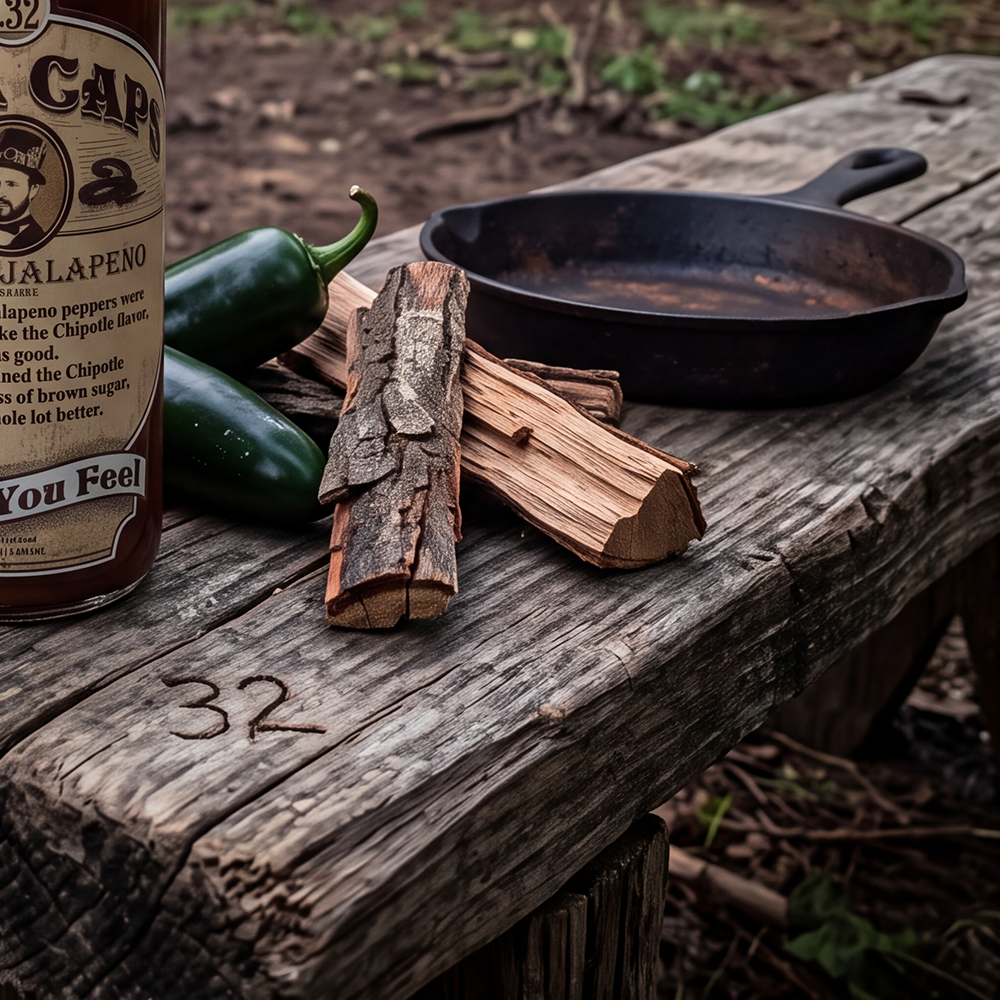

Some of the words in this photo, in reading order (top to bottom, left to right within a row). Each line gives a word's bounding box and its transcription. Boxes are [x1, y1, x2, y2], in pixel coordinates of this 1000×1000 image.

[28, 54, 161, 163] CAPS
[61, 297, 118, 321] peppers
[120, 289, 145, 306] were
[22, 325, 49, 341] the
[53, 317, 115, 340] Chipotle
[117, 308, 149, 328] flavor,
[13, 345, 59, 367] good.
[36, 366, 62, 382] the
[65, 356, 124, 380] Chipotle
[16, 388, 35, 405] of
[37, 386, 88, 404] brown
[91, 378, 130, 398] sugar,
[30, 409, 52, 425] lot
[56, 405, 104, 422] better.
[76, 458, 141, 498] Feel
[160, 674, 328, 741] 32
